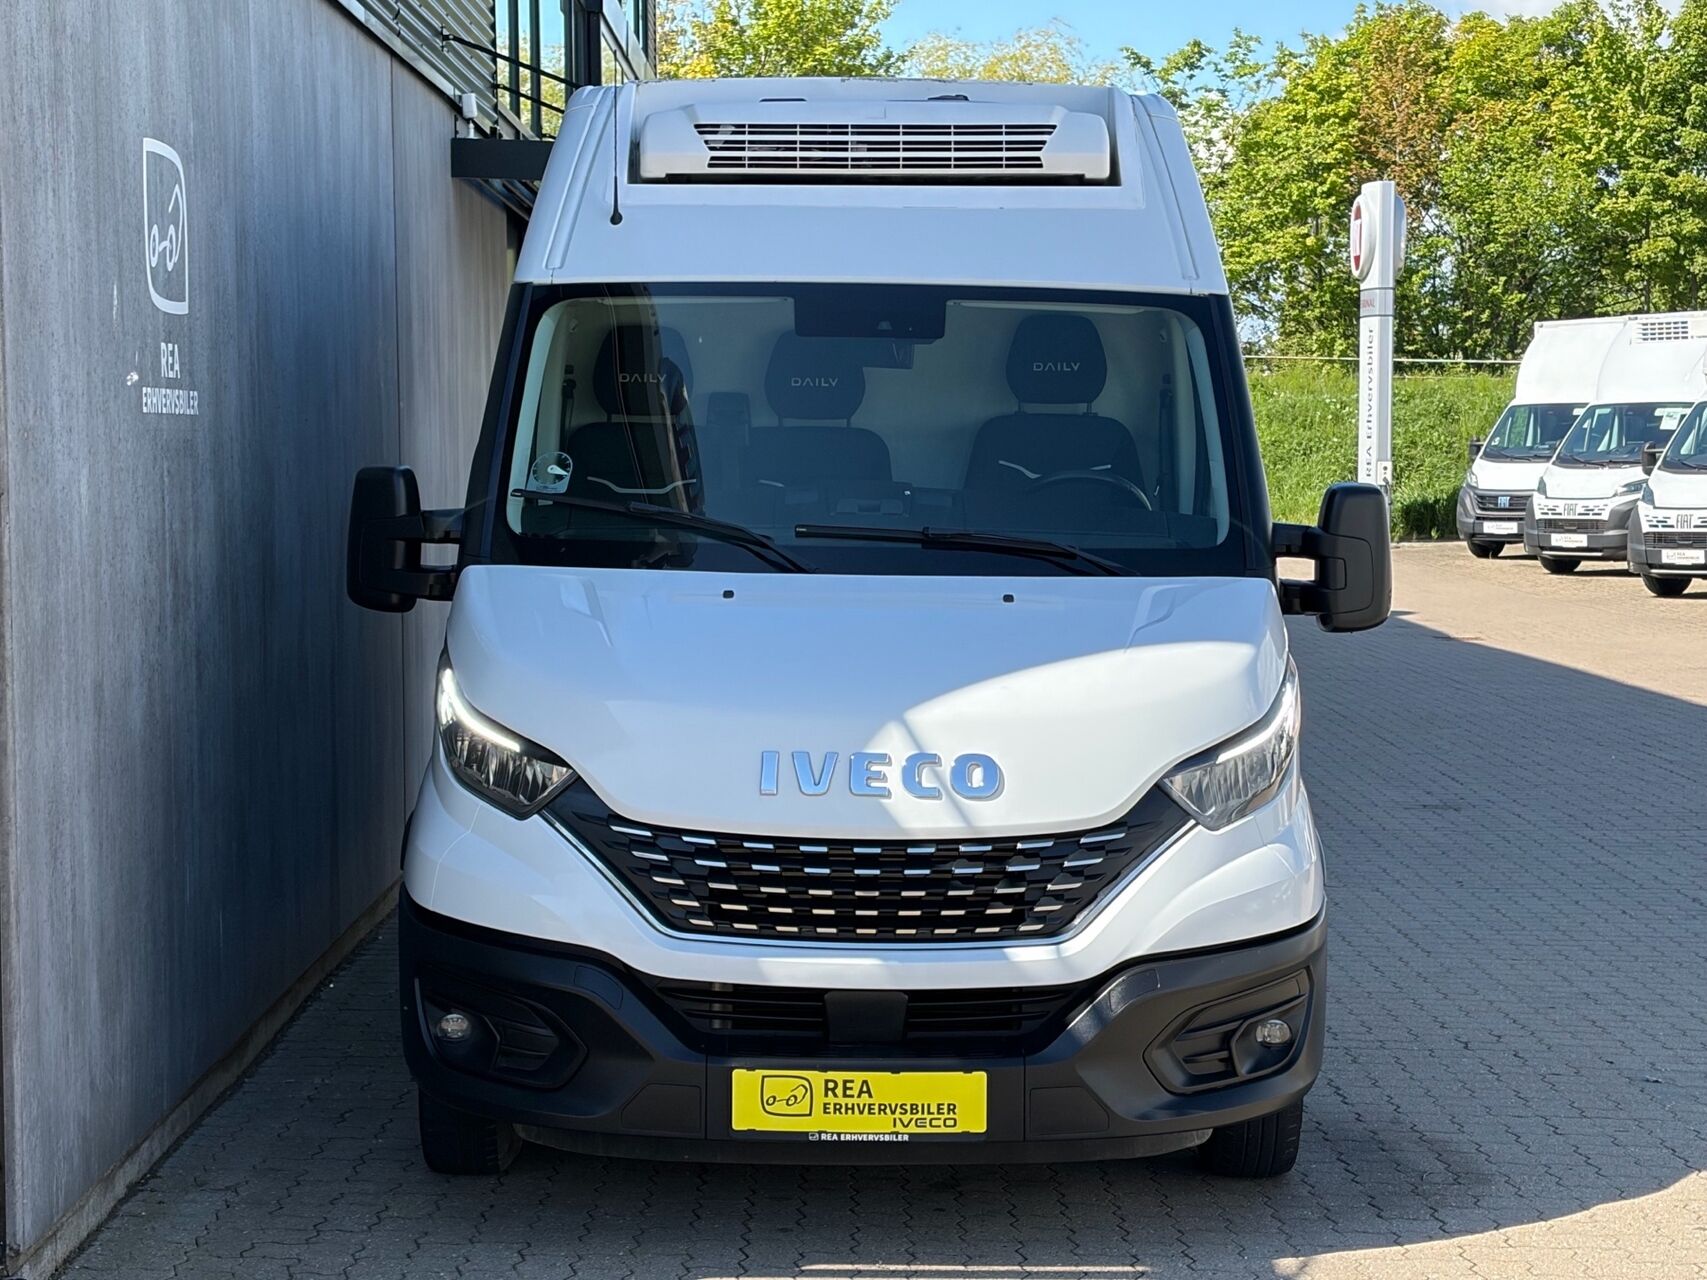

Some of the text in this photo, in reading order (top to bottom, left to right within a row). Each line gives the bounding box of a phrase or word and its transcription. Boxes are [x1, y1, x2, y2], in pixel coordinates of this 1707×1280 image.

[160, 342, 180, 379] REA
[1032, 362, 1080, 371] DAILY
[619, 373, 667, 383] DAILY
[791, 377, 839, 387] DAILY
[142, 386, 199, 415] ERHVERVSBILER
[1563, 503, 1578, 517] FIAT
[1676, 513, 1694, 529] FIAT
[760, 751, 1005, 801] IVECO
[823, 1079, 873, 1099] REA
[822, 1103, 957, 1115] ERHVERVSBILER
[893, 1117, 957, 1129] IVECO
[821, 1133, 909, 1142] REA ERHVERVSBILER
